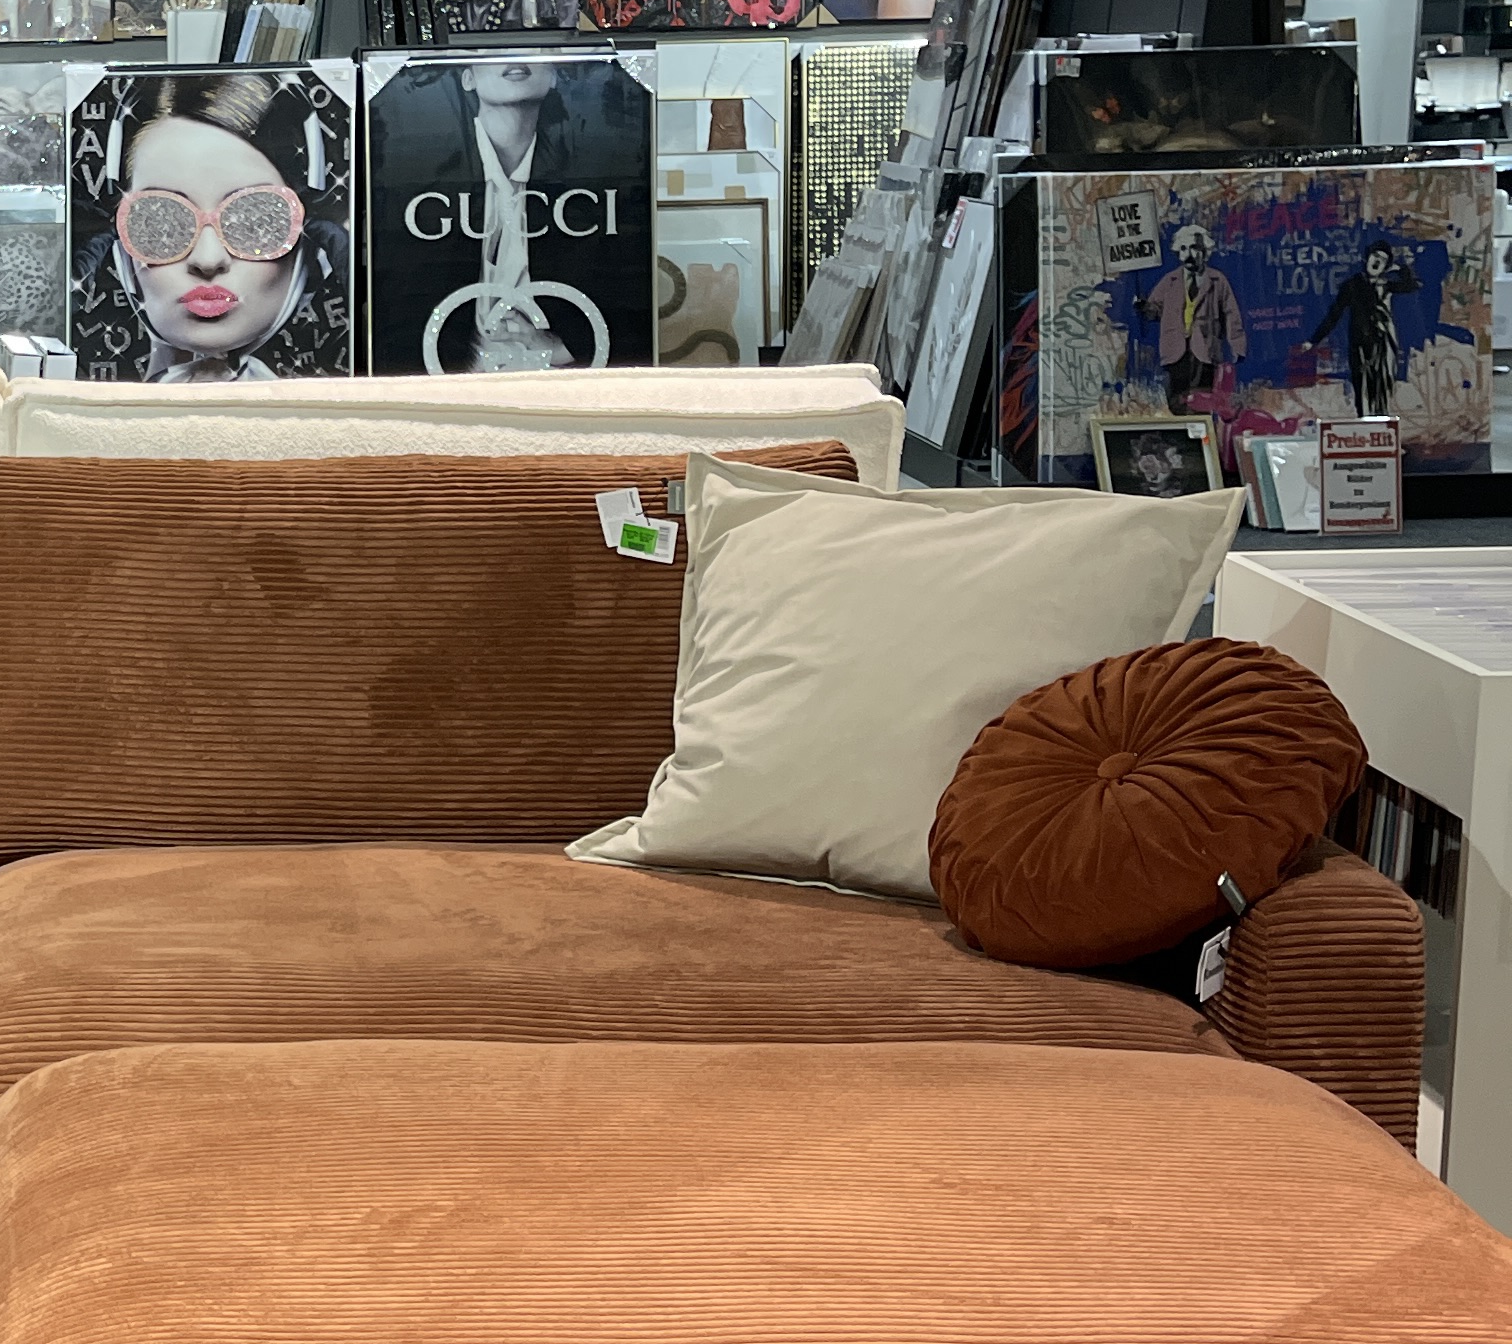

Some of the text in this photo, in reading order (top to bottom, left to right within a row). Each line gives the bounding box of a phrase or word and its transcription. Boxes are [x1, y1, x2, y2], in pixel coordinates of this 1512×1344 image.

[404, 188, 619, 240] GUCCI
[1111, 203, 1141, 223] LOVE
[1110, 240, 1157, 262] ANSWER
[1266, 243, 1328, 266] NEED
[1276, 265, 1349, 296] LOVE
[1327, 431, 1394, 448] Preis-Hit
